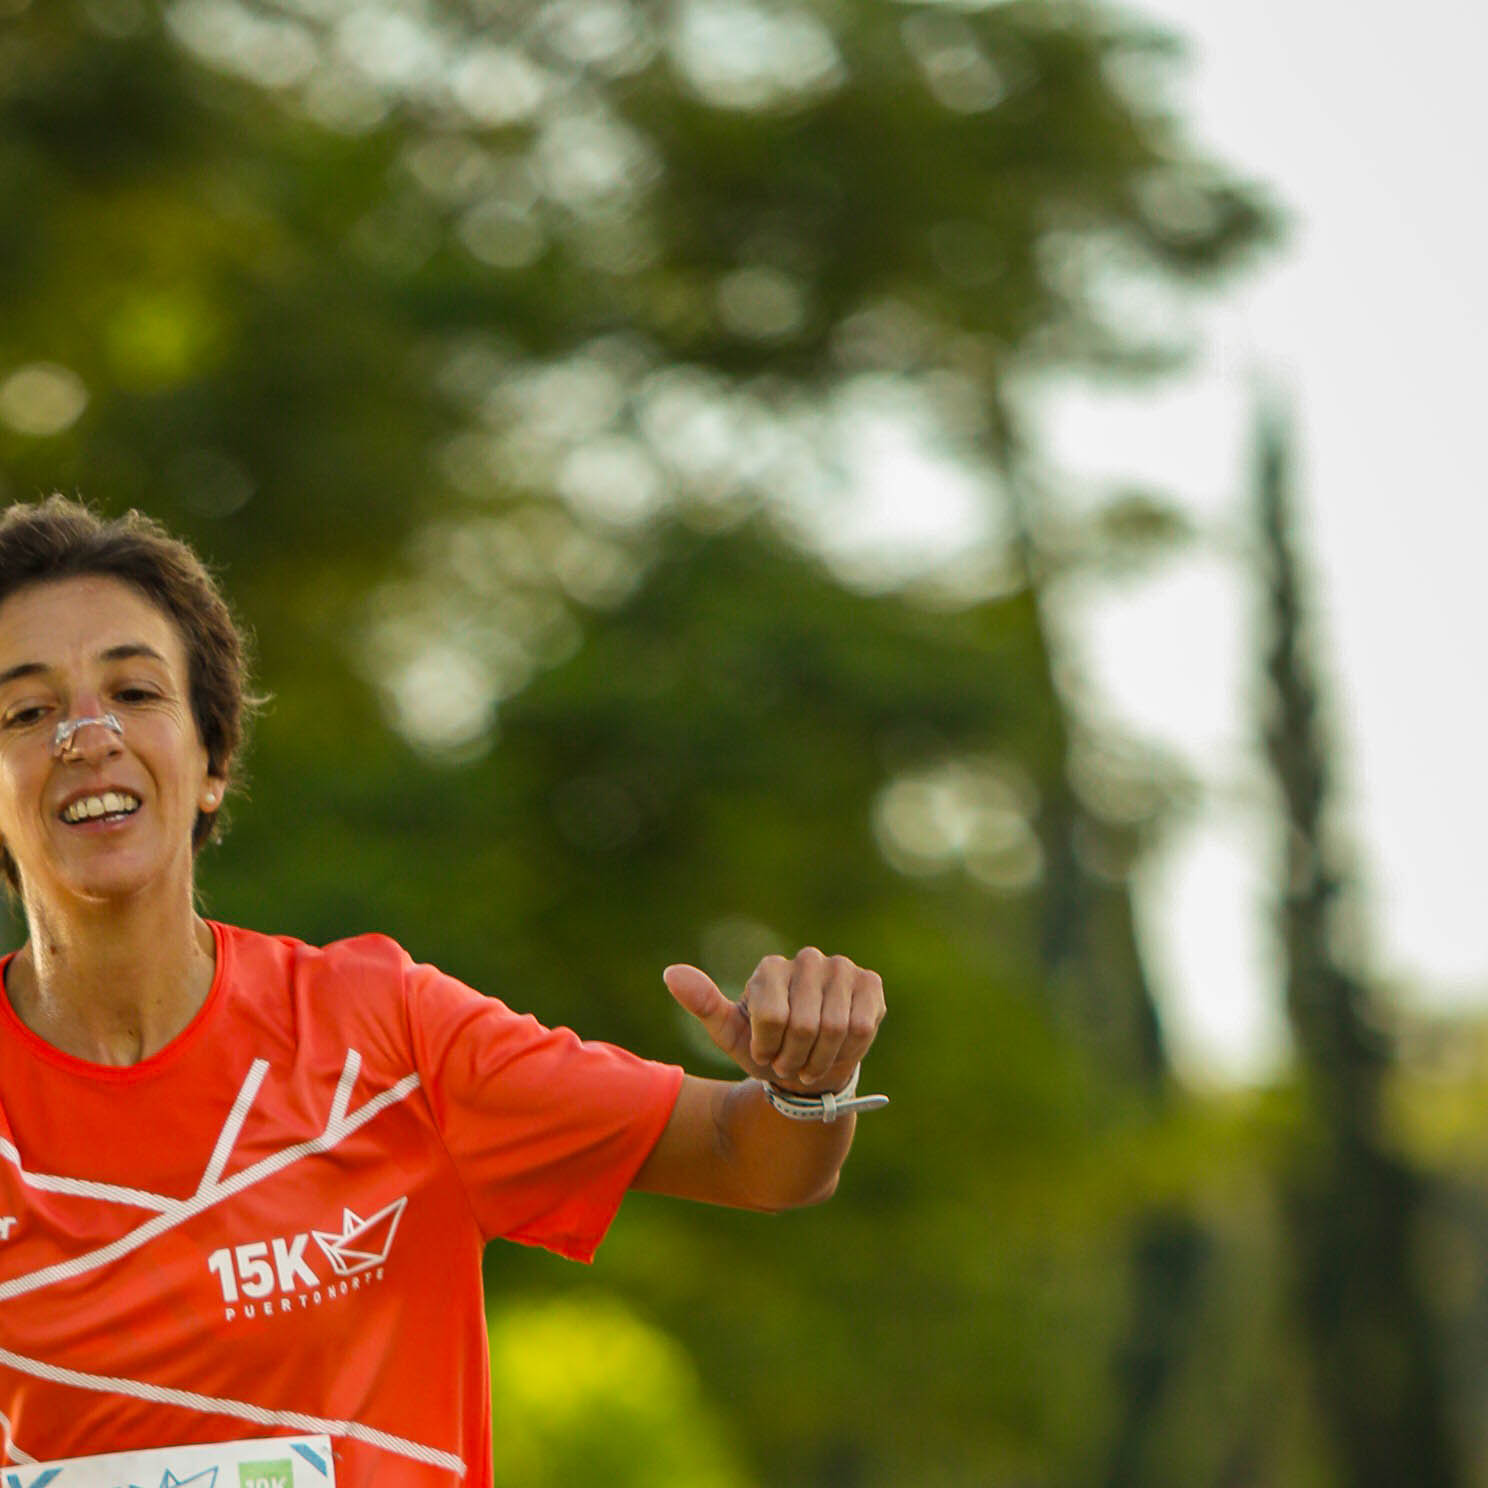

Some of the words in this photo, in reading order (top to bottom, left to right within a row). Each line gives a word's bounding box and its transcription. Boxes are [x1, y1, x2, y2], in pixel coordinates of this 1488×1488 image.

[208, 1233, 320, 1302] 15K
[225, 1291, 321, 1321] PUERTO
[328, 1268, 384, 1298] NORTE
